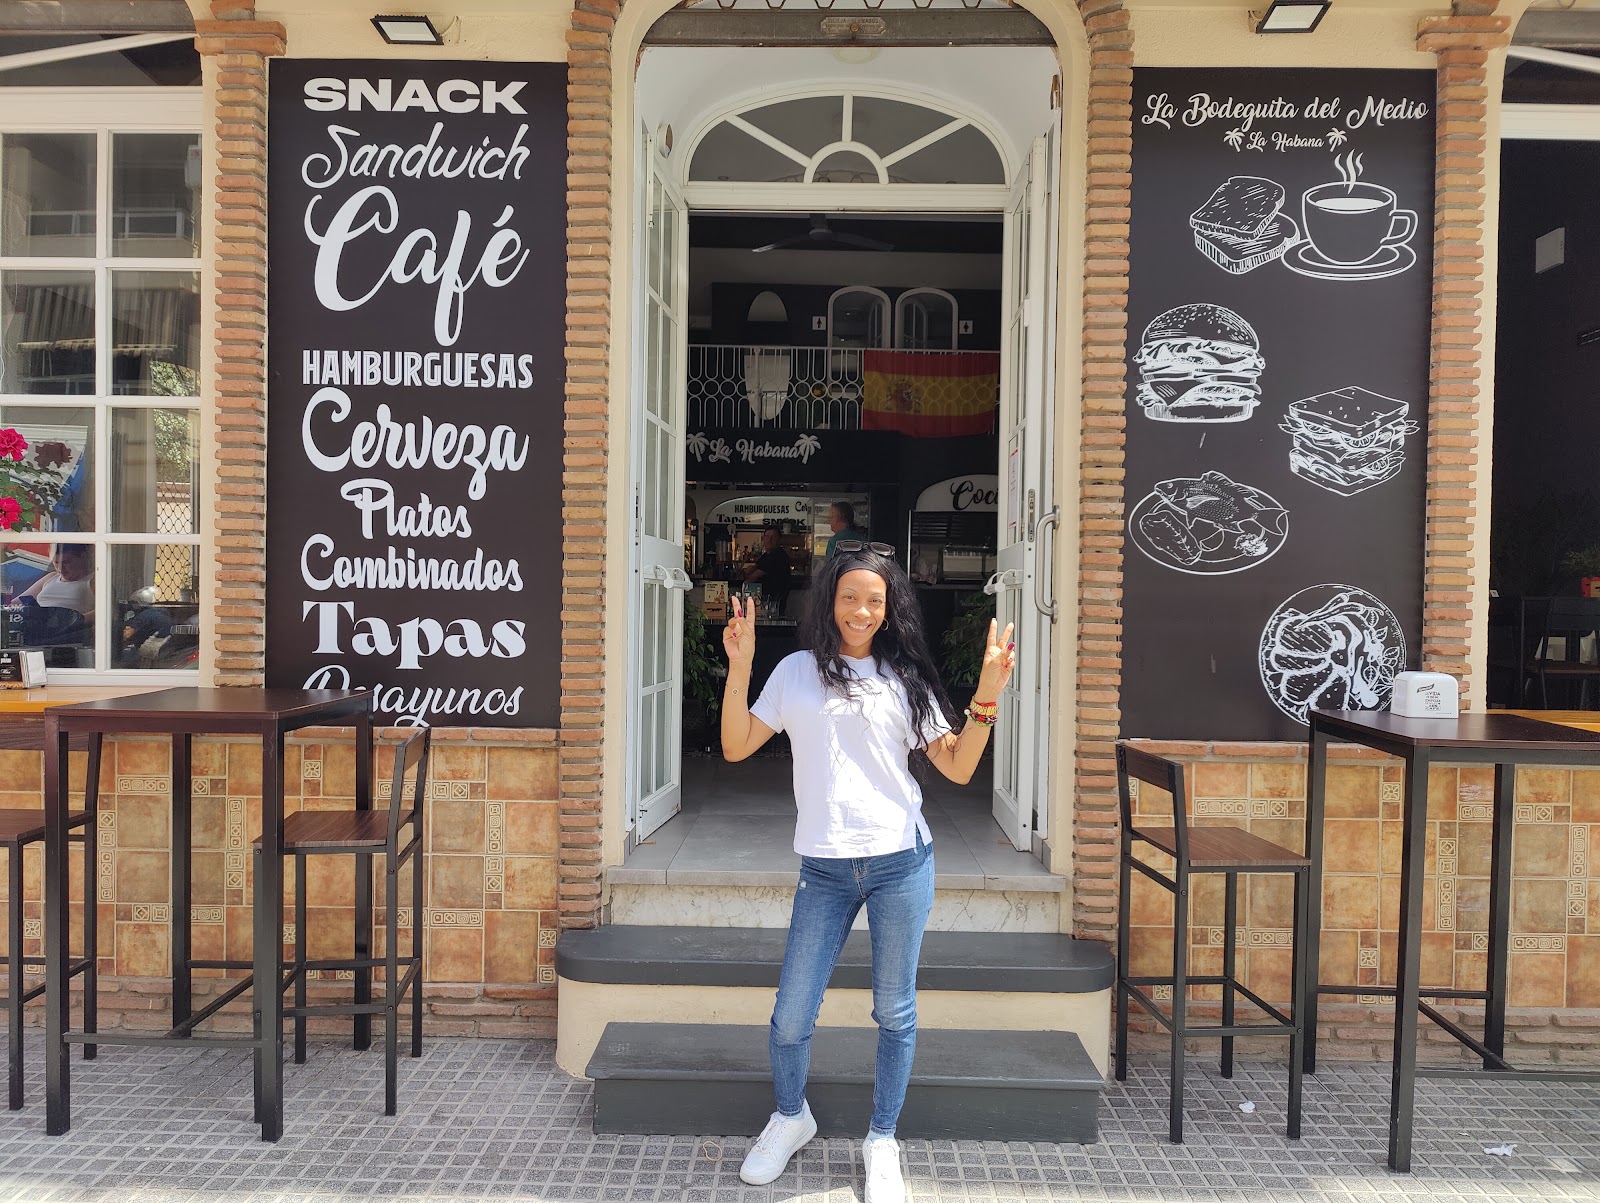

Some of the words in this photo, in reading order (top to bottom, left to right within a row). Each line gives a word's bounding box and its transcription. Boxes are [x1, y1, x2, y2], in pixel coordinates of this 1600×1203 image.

[304, 77, 529, 115] SNACK
[1141, 93, 1178, 130] La
[1181, 92, 1299, 133] Bodeguita
[1303, 96, 1342, 119] del
[1345, 95, 1429, 130] Medio
[301, 121, 531, 189] Sandwich
[1246, 131, 1268, 153] La
[1271, 131, 1325, 153] Habana
[303, 185, 531, 347] Café
[302, 349, 534, 389] HAMBURGUESAS
[301, 387, 530, 501] Cerveza
[709, 437, 733, 464] La
[736, 437, 801, 465] Habana
[340, 478, 472, 540] Platos
[734, 504, 790, 514] HAMBURGUESAS
[300, 533, 524, 592] Combinados
[302, 600, 527, 670] Tapas
[302, 664, 525, 729] Dsayunos
